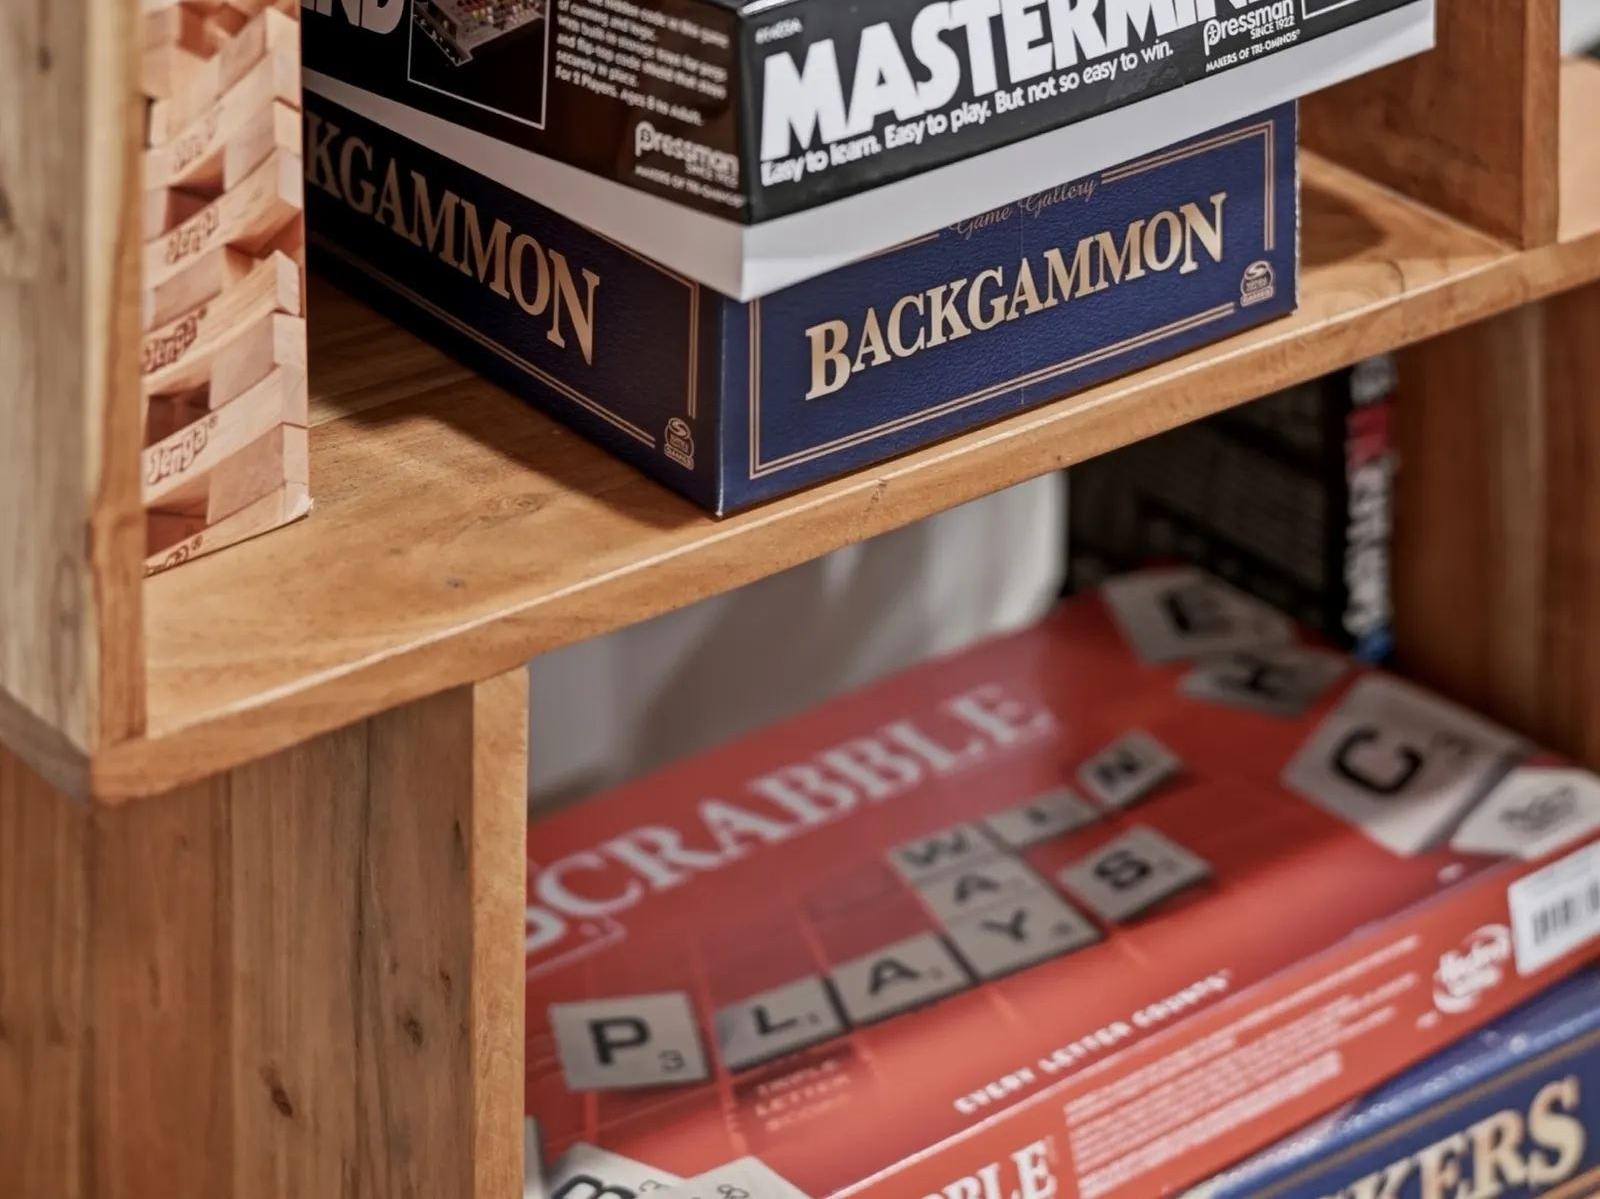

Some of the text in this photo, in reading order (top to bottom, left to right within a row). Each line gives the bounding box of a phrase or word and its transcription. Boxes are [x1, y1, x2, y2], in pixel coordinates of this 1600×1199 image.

[1205, 51, 1239, 74] MAKERS
[1239, 46, 1251, 63] OF
[1250, 15, 1296, 41] SINCE 1922
[760, 157, 805, 187] Easy
[805, 148, 829, 173] to
[830, 134, 882, 167] learn.
[884, 119, 926, 150] Easy
[926, 112, 949, 136] to
[950, 99, 993, 134] play.
[994, 88, 1025, 115] But
[1027, 78, 1058, 105] not
[1059, 72, 1081, 90] so
[1082, 57, 1119, 85] easy
[1120, 51, 1139, 72] to
[1140, 38, 1175, 64] win.
[804, 191, 1228, 401] BACKGAMMON
[1315, 1074, 1586, 1199] KERS
